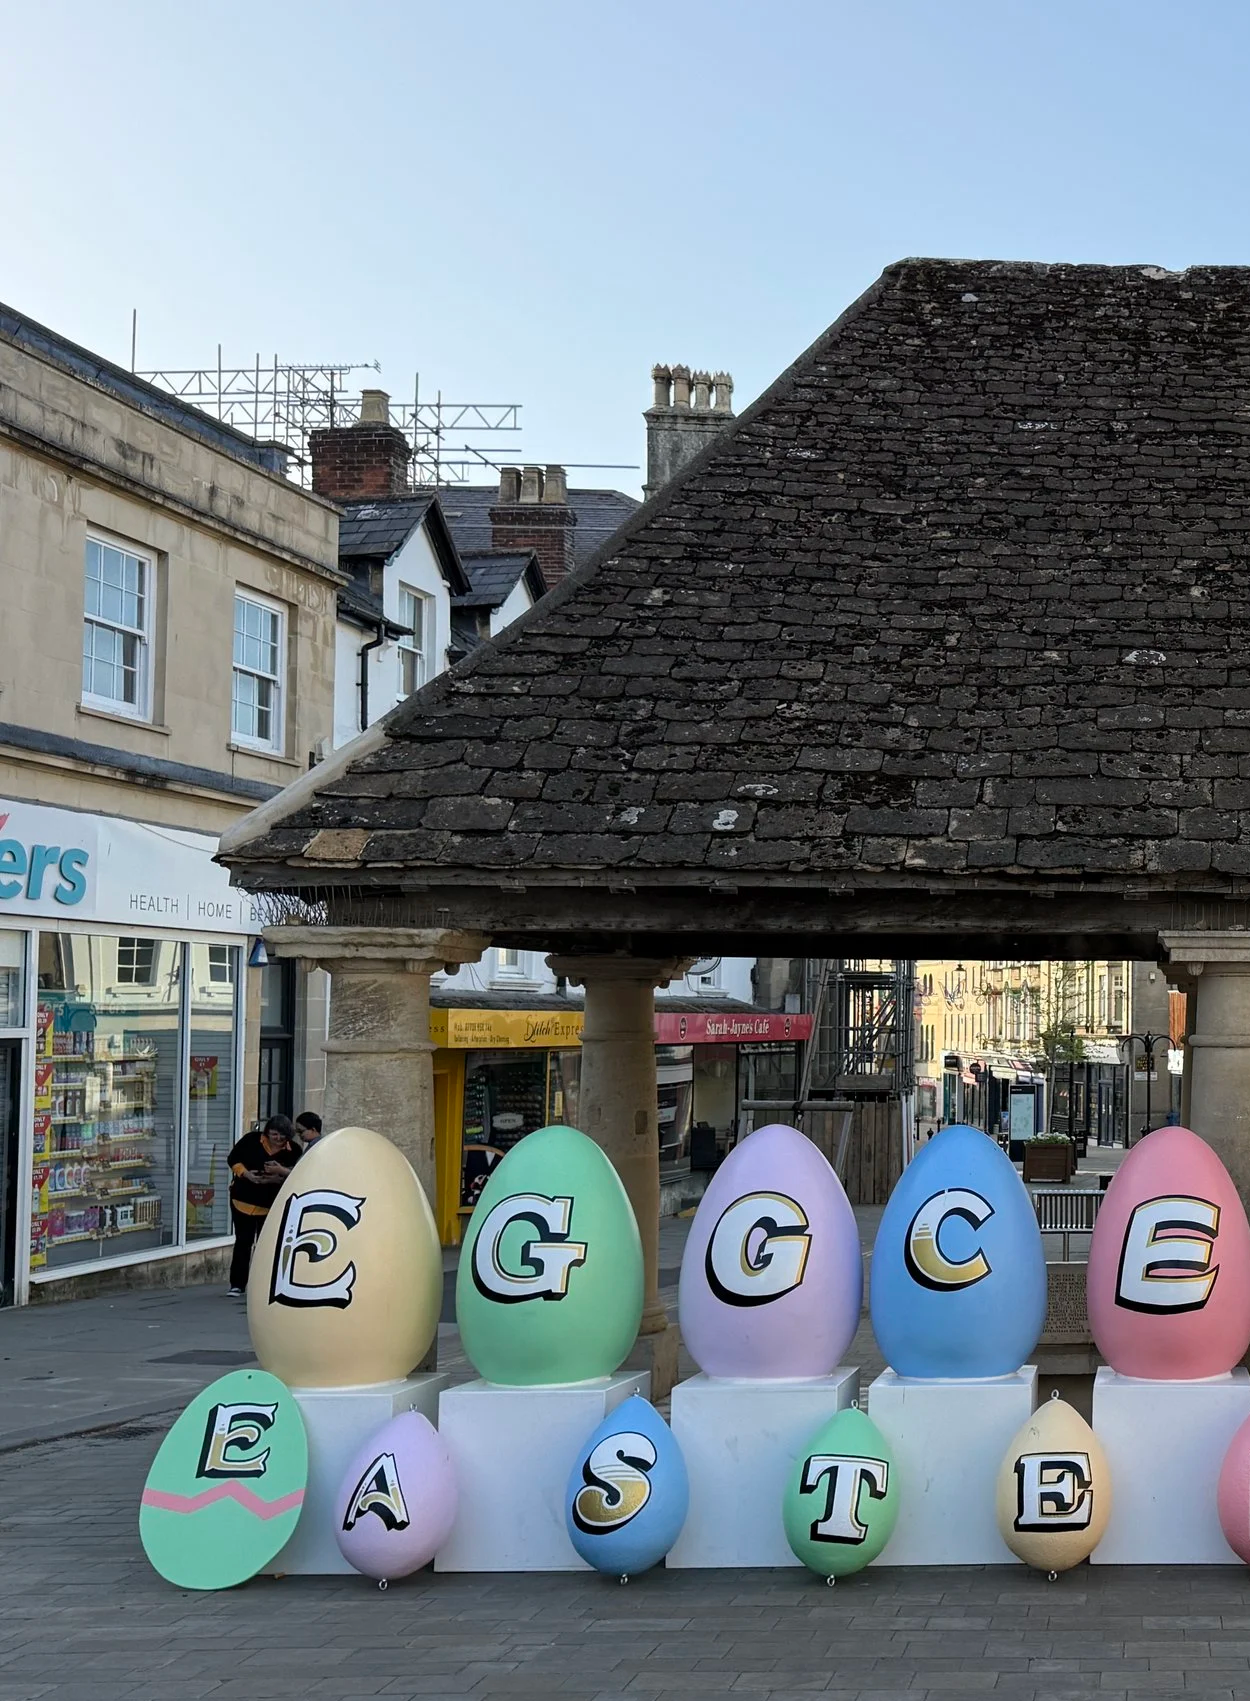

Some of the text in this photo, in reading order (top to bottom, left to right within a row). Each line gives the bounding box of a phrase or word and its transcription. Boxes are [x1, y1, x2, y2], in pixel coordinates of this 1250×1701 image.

[129, 893, 179, 914] HEALTH
[198, 901, 232, 919] HOME
[554, 1021, 585, 1040] Expres
[706, 1018, 753, 1037] Sarah-Jayne's
[754, 1018, 769, 1034] Café
